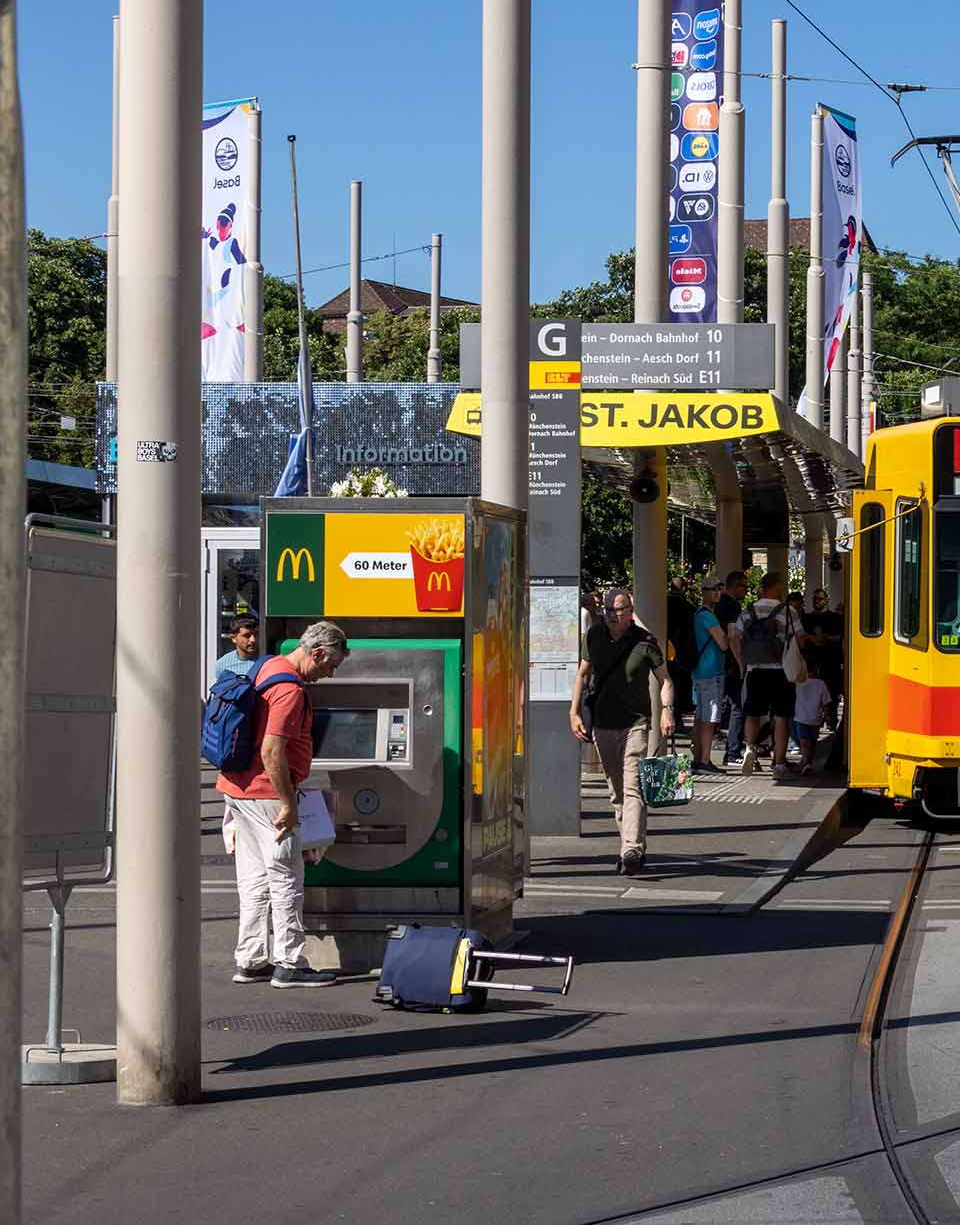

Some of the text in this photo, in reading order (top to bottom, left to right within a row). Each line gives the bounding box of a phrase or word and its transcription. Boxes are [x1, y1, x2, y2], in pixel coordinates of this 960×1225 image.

[836, 180, 856, 196] Basel
[537, 323, 567, 357] G
[610, 332, 652, 343] Dornach
[656, 332, 699, 343] Bahnhof
[706, 330, 722, 343] 10
[581, 353, 631, 364] chenstein
[642, 353, 673, 364] Aesch
[676, 353, 699, 364] Dorf
[706, 350, 721, 363] 11
[547, 372, 570, 383] BLT
[583, 374, 619, 384] enstein
[631, 373, 670, 384] Reinach
[673, 372, 693, 384] Süd
[699, 370, 721, 384] E11
[580, 402, 764, 429] ST. JAKOB
[336, 444, 467, 463] Information
[354, 560, 407, 571] 60 Meter
